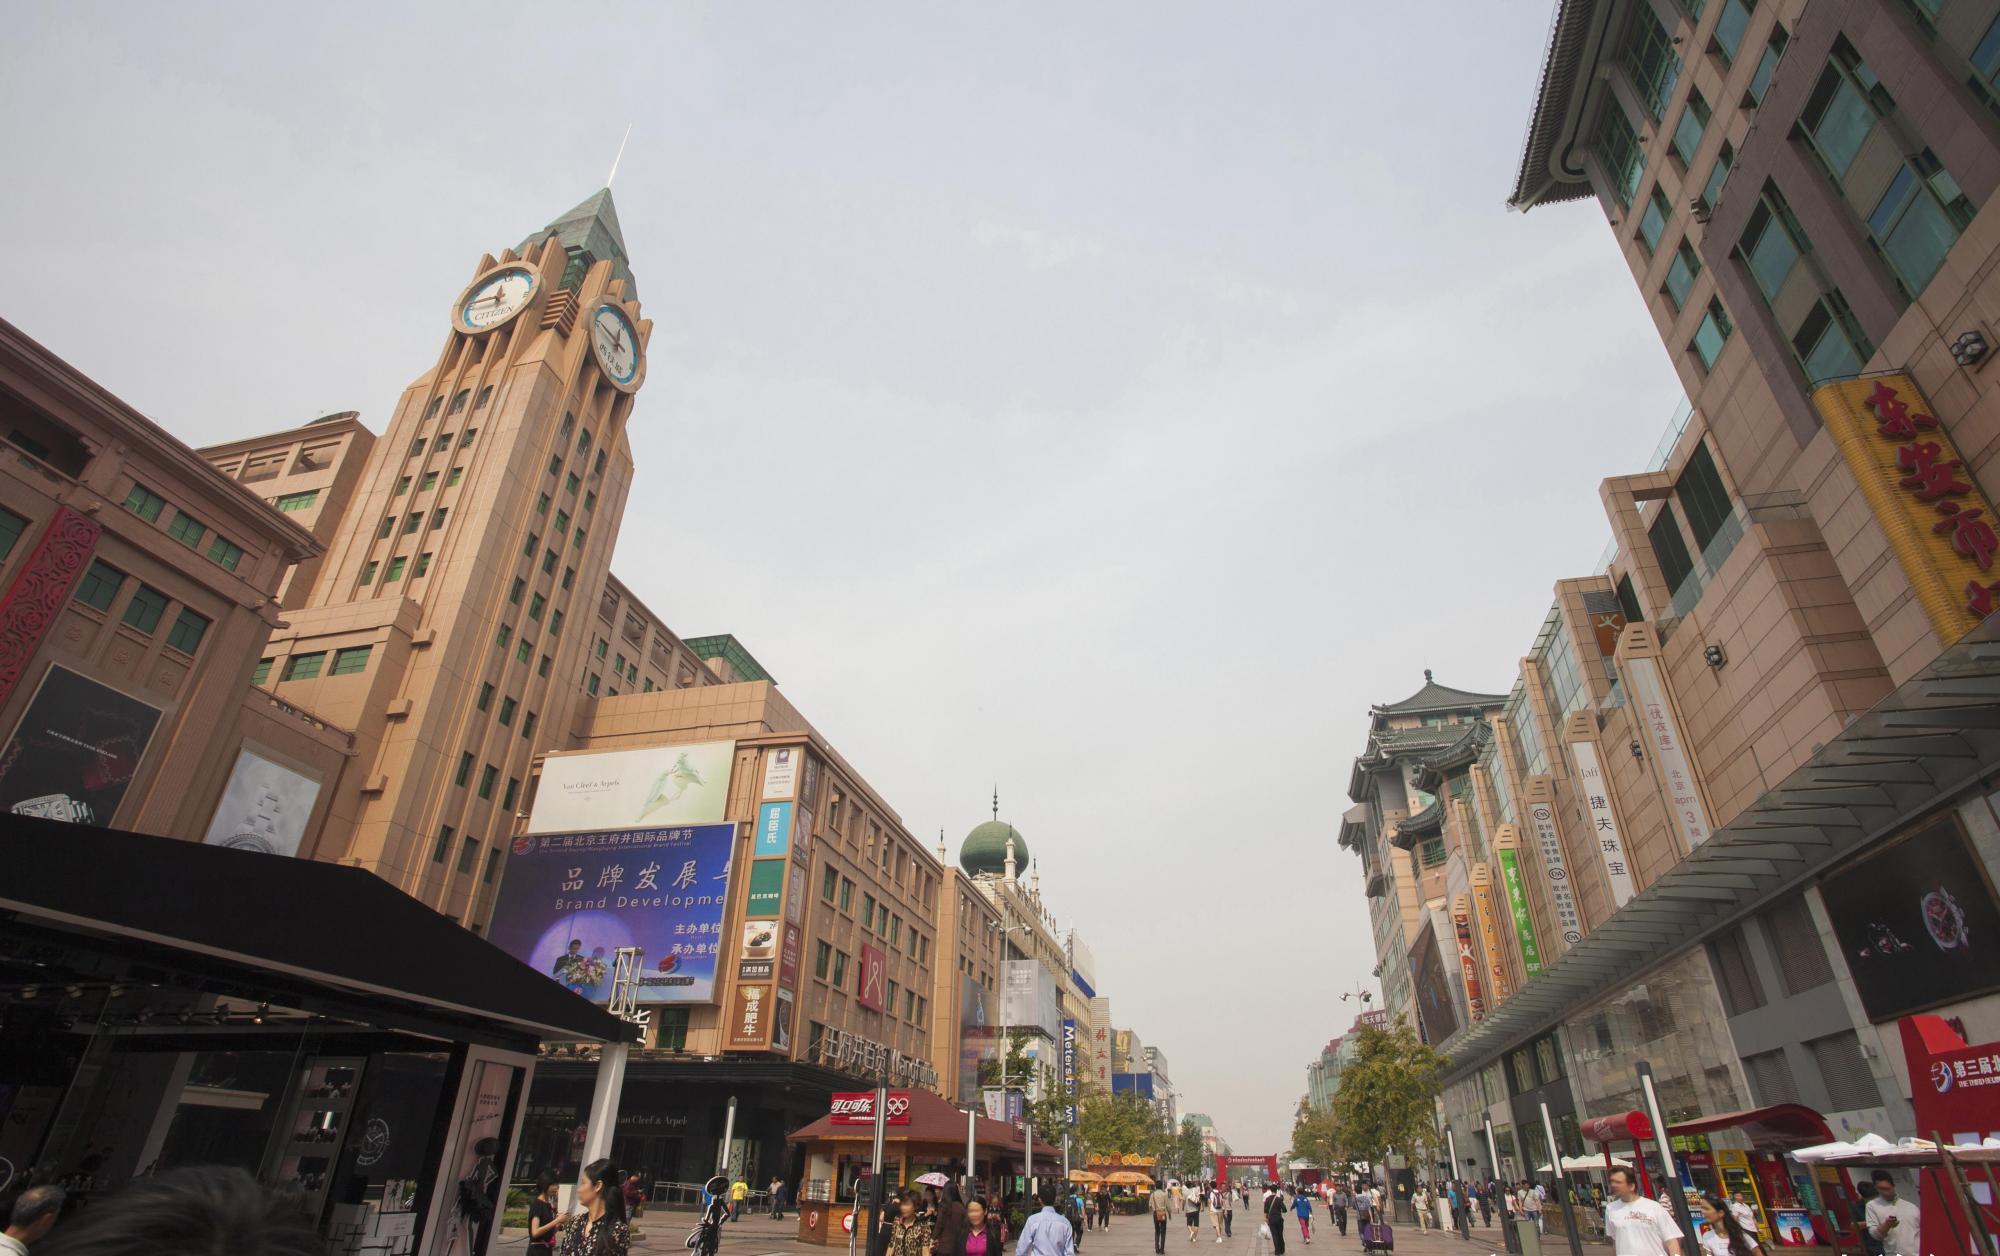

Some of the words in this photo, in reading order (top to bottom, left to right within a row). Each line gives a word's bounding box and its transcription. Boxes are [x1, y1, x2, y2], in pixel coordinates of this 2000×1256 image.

[474, 306, 514, 321] CITIZEN
[540, 829, 693, 848] 第二届北京王府井国际品牌节
[1590, 795, 1627, 876] 捷夫珠宝
[556, 897, 606, 910] Brand
[675, 922, 721, 935] 主办单位
[670, 943, 719, 955] 承办单位
[742, 988, 761, 1036] 福成肥牛
